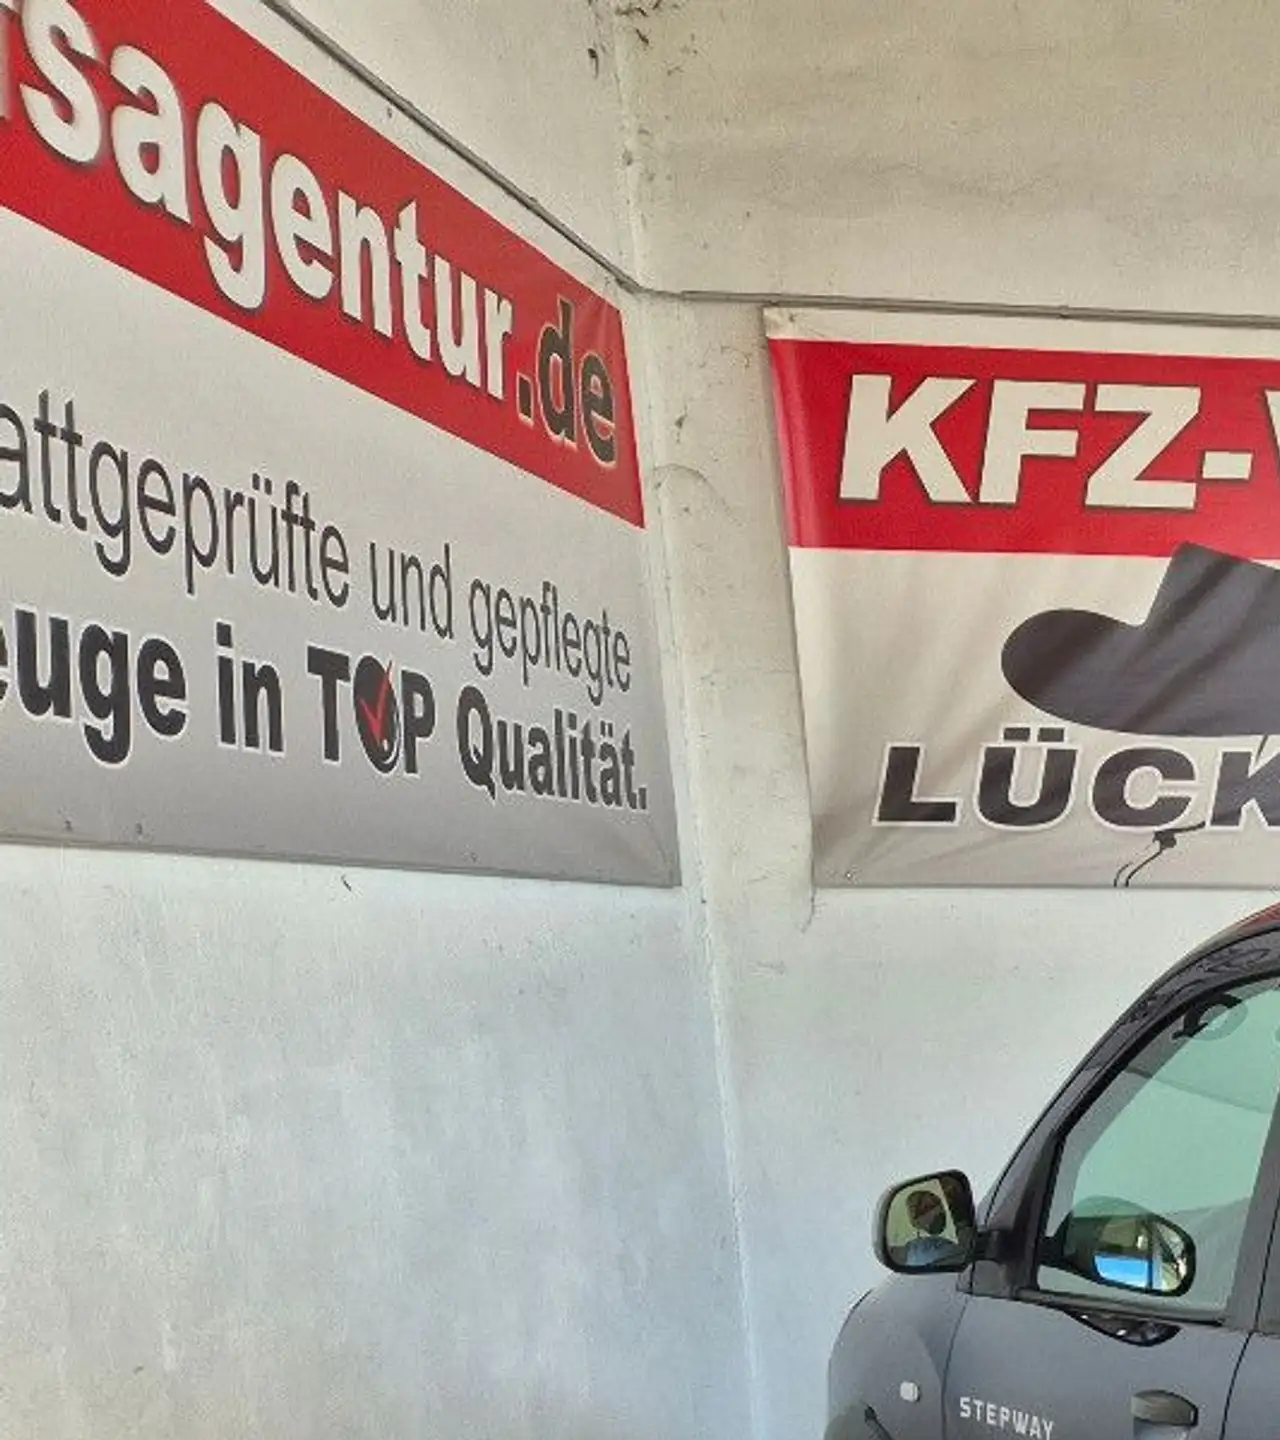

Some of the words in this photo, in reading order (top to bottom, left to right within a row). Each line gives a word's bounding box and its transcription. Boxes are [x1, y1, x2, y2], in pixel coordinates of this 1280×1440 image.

[0, 0, 617, 467] sagentur.de
[0, 608, 187, 765] uge
[215, 621, 284, 754] in
[457, 685, 648, 811] Qualität.
[369, 543, 455, 641] und
[469, 577, 632, 706] gepflegte
